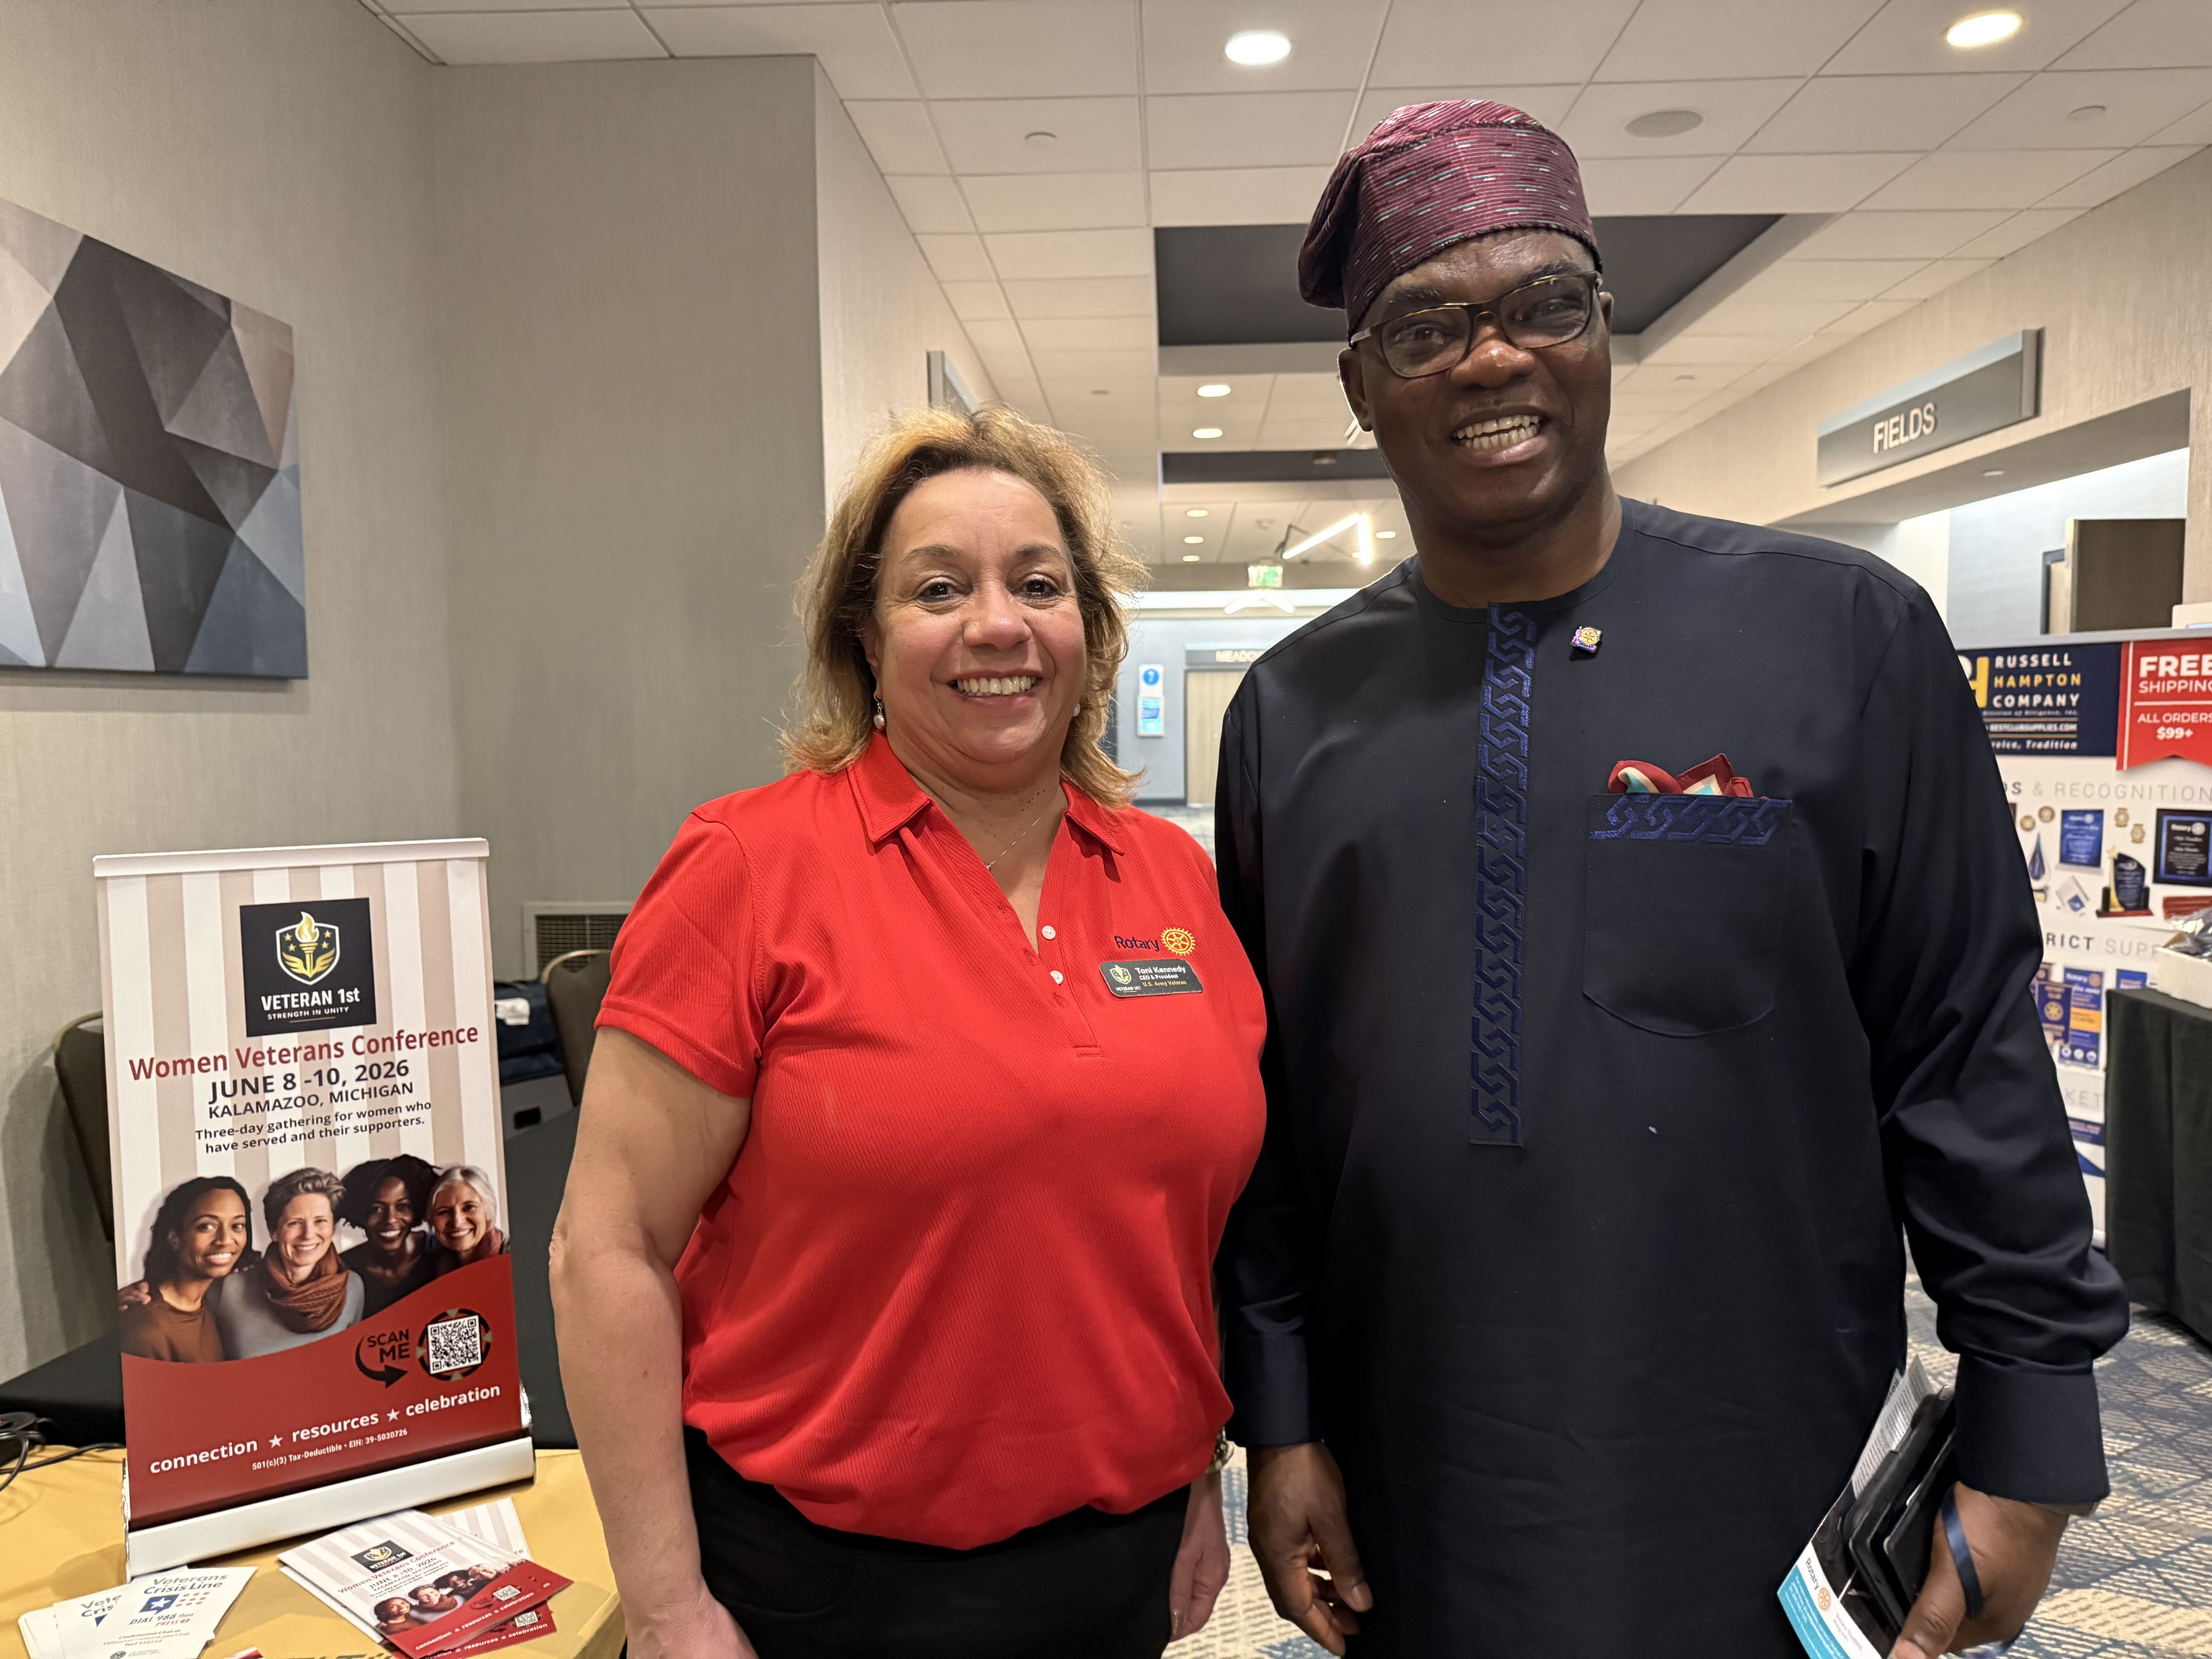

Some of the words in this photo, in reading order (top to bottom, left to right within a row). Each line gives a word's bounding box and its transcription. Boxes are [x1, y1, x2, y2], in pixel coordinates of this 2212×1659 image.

[1874, 403, 1935, 454] FIELDS
[1995, 653, 2072, 668] RUSSELL
[2140, 654, 2212, 678] FREE
[1994, 673, 2081, 688] HAMPTON
[1993, 693, 2080, 708] COMPANY
[2137, 713, 2160, 723] ALL
[2157, 726, 2193, 740] $99+
[2054, 782, 2212, 802] RECOGNITION
[1114, 936, 1159, 952] Rotary
[2046, 933, 2094, 951] RICT
[1153, 965, 1186, 974] Kennedy
[261, 990, 332, 1011] VETERAN
[338, 988, 360, 1004] 1st
[268, 1010, 309, 1020] STRENGTH
[324, 1006, 349, 1015] UNITY
[129, 1053, 228, 1080] Women
[235, 1041, 344, 1069] Veterans
[352, 1026, 478, 1056] Conference
[209, 1075, 275, 1104] JUNE
[283, 1073, 297, 1090] 8
[304, 1068, 347, 1087] -10,
[355, 1060, 409, 1082] 2026
[209, 1094, 323, 1118] KALAMAZOO,
[330, 1082, 413, 1104] MICHIGAN
[195, 1124, 263, 1140] Three-day
[268, 1115, 331, 1133] gathering
[335, 1112, 352, 1121] for
[357, 1106, 402, 1119] women
[406, 1101, 432, 1112] who
[206, 1142, 238, 1153] have
[242, 1133, 287, 1149] served
[291, 1129, 315, 1142] and
[319, 1125, 349, 1138] their
[354, 1116, 425, 1134] supporters.
[367, 1329, 409, 1348] SCAN
[380, 1343, 410, 1363] ME
[150, 1440, 258, 1474] connection
[292, 1413, 379, 1442] resources
[405, 1385, 500, 1416] celebration
[252, 1455, 287, 1470] 501(c)(3)
[289, 1443, 342, 1462] Tax-Deductible
[349, 1439, 364, 1448] EIN:
[365, 1428, 408, 1444] 39-5030726
[338, 1578, 372, 1593] Women
[372, 1561, 410, 1579] Veterans
[410, 1541, 455, 1563] Conference
[369, 1577, 392, 1589] JUNE
[416, 1558, 437, 1567] 2026
[1805, 1557, 1820, 1590] Rotary
[144, 1582, 188, 1594] Crisis
[188, 1581, 223, 1590] Line
[153, 1574, 228, 1586] Veterans
[129, 1616, 154, 1625] DIAL
[157, 1613, 177, 1621] 988
[416, 1632, 452, 1650] connection
[462, 1613, 493, 1629] resources
[500, 1592, 534, 1611] celebration
[464, 1637, 498, 1650] resources
[508, 1623, 548, 1638] celebration
